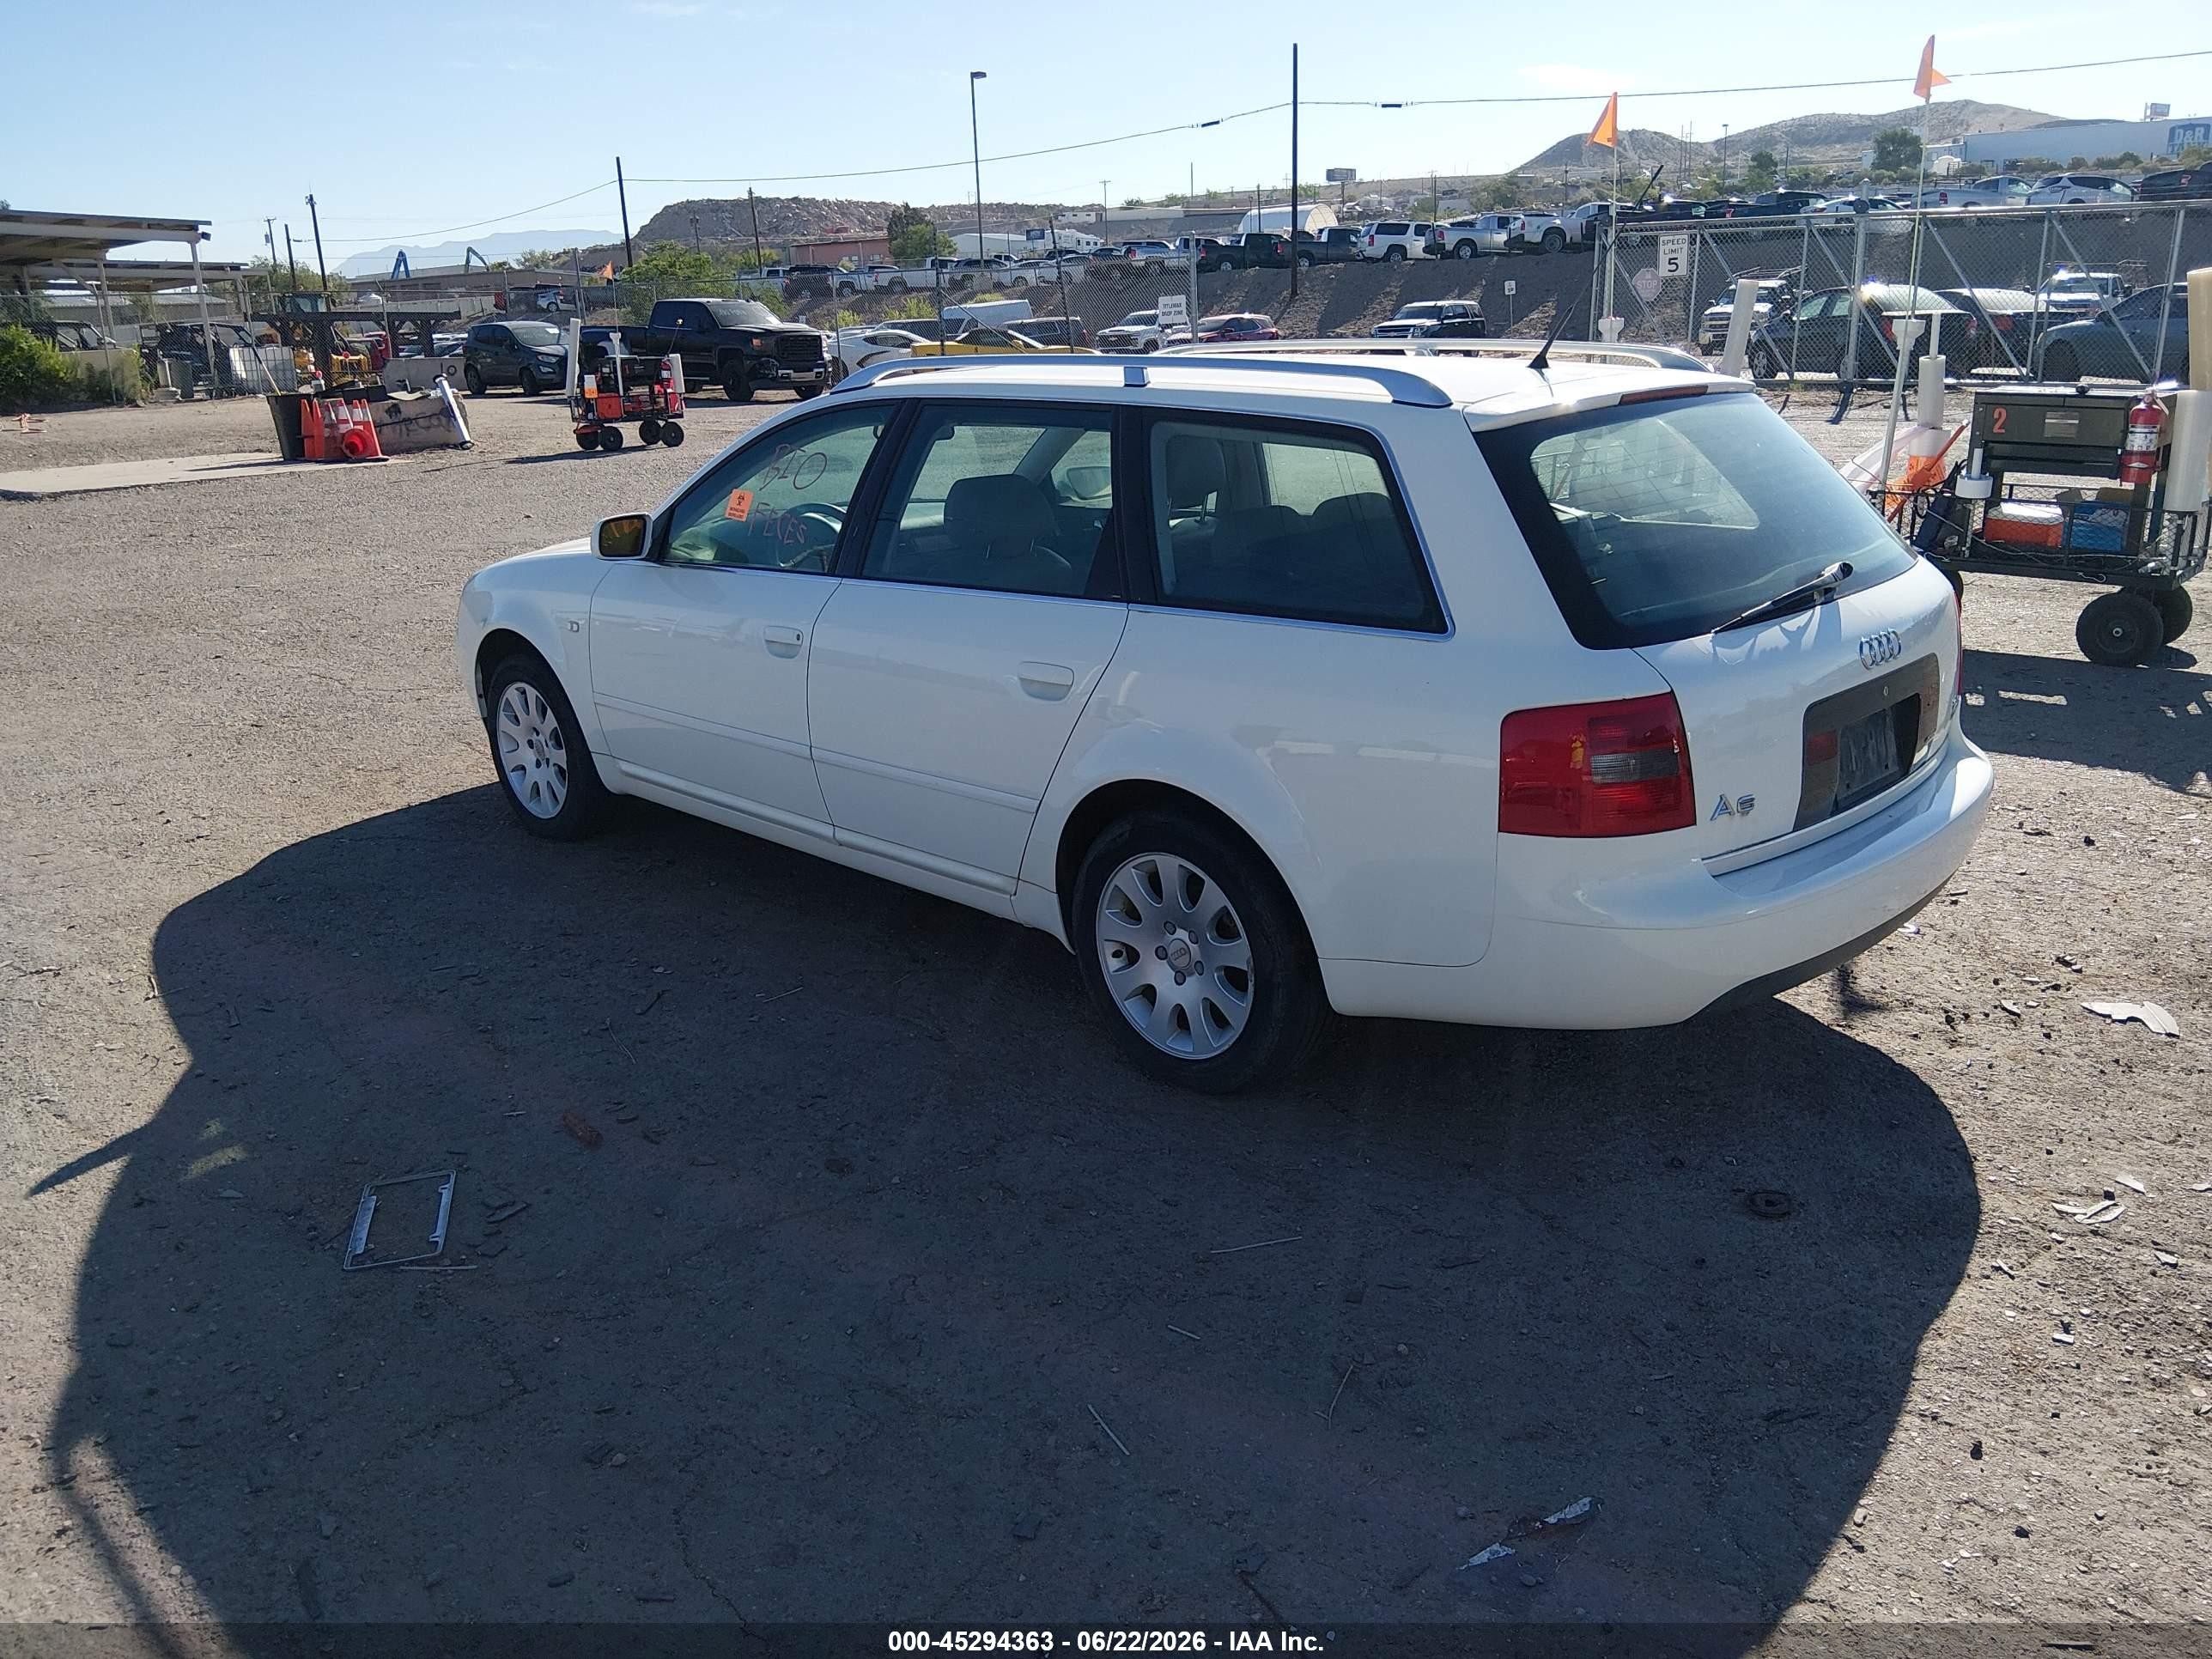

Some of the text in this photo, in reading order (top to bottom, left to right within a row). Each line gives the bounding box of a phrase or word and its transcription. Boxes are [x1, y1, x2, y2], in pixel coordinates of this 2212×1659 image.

[2174, 127, 2205, 143] D&R
[1668, 257, 1679, 272] 5
[1636, 280, 1657, 289] STOP
[1992, 407, 2007, 434] 2
[758, 443, 828, 490] BIO
[747, 501, 807, 544] FECES
[1710, 793, 1756, 822] A6
